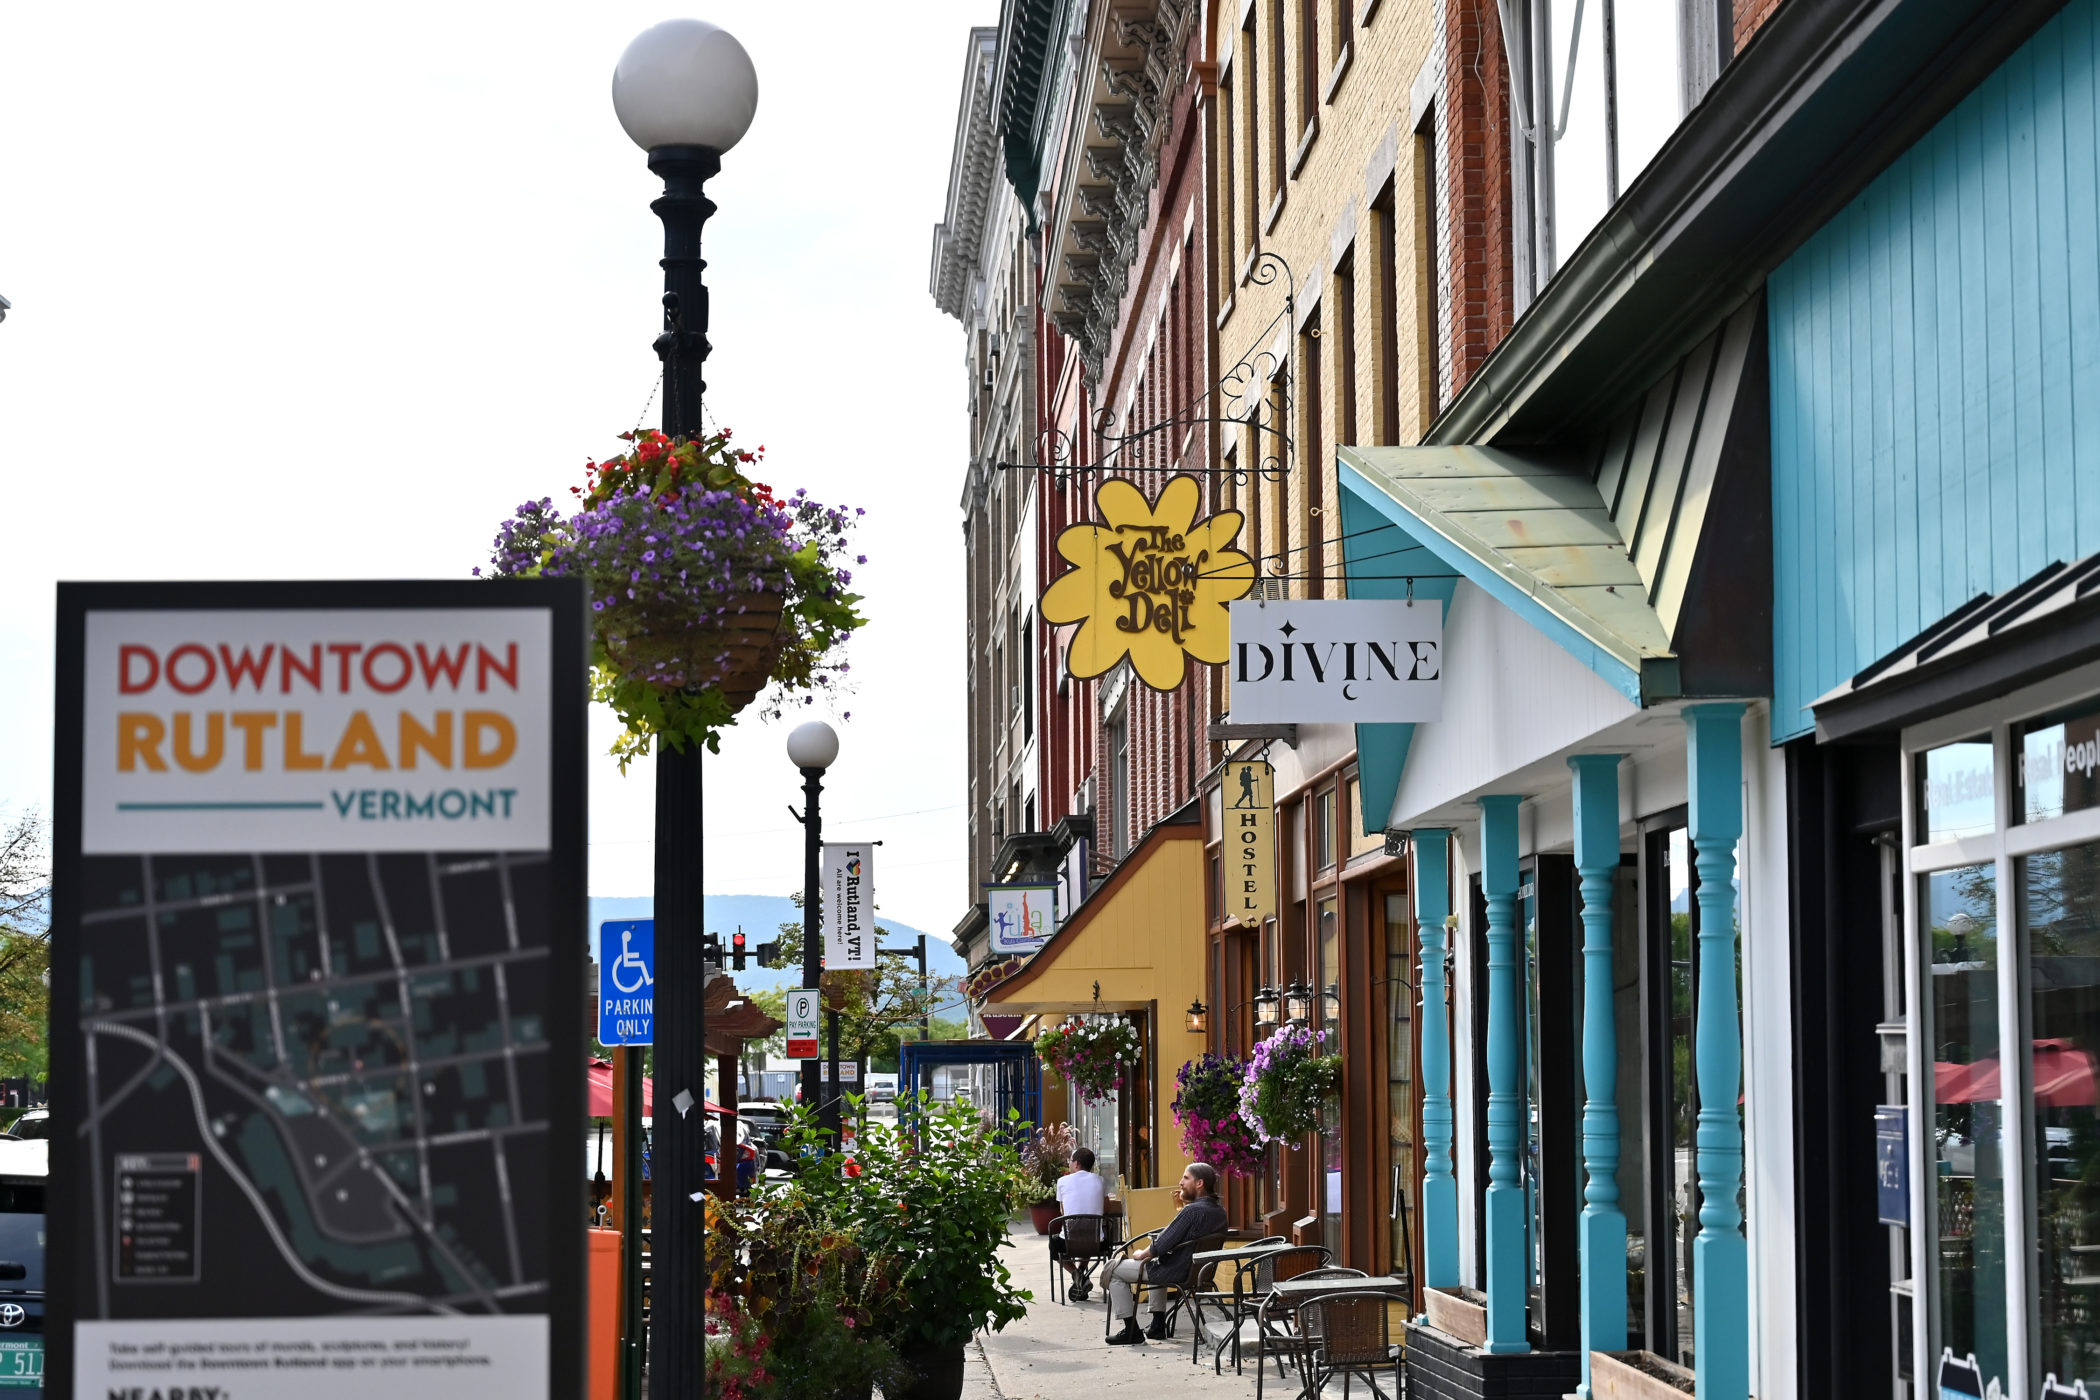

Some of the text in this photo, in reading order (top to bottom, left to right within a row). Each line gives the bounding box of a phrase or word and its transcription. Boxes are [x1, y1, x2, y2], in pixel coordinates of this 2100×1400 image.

[1116, 524, 1185, 552] The
[1106, 541, 1208, 599] Yellow
[1116, 590, 1196, 644] Deli
[117, 641, 519, 695] DOWNTOWN
[116, 709, 519, 773] RUTLAND
[2056, 729, 2100, 779] Peopl
[1955, 763, 1994, 804] Estat
[330, 788, 518, 821] VERMONT
[1239, 814, 1257, 910] HOSTEL
[844, 876, 860, 936] Rutland,
[836, 926, 844, 945] here!
[847, 936, 861, 961] VT!
[605, 998, 653, 1015] PARKIN
[789, 1021, 816, 1029] PAY PARKING
[616, 1019, 650, 1036] ONLY
